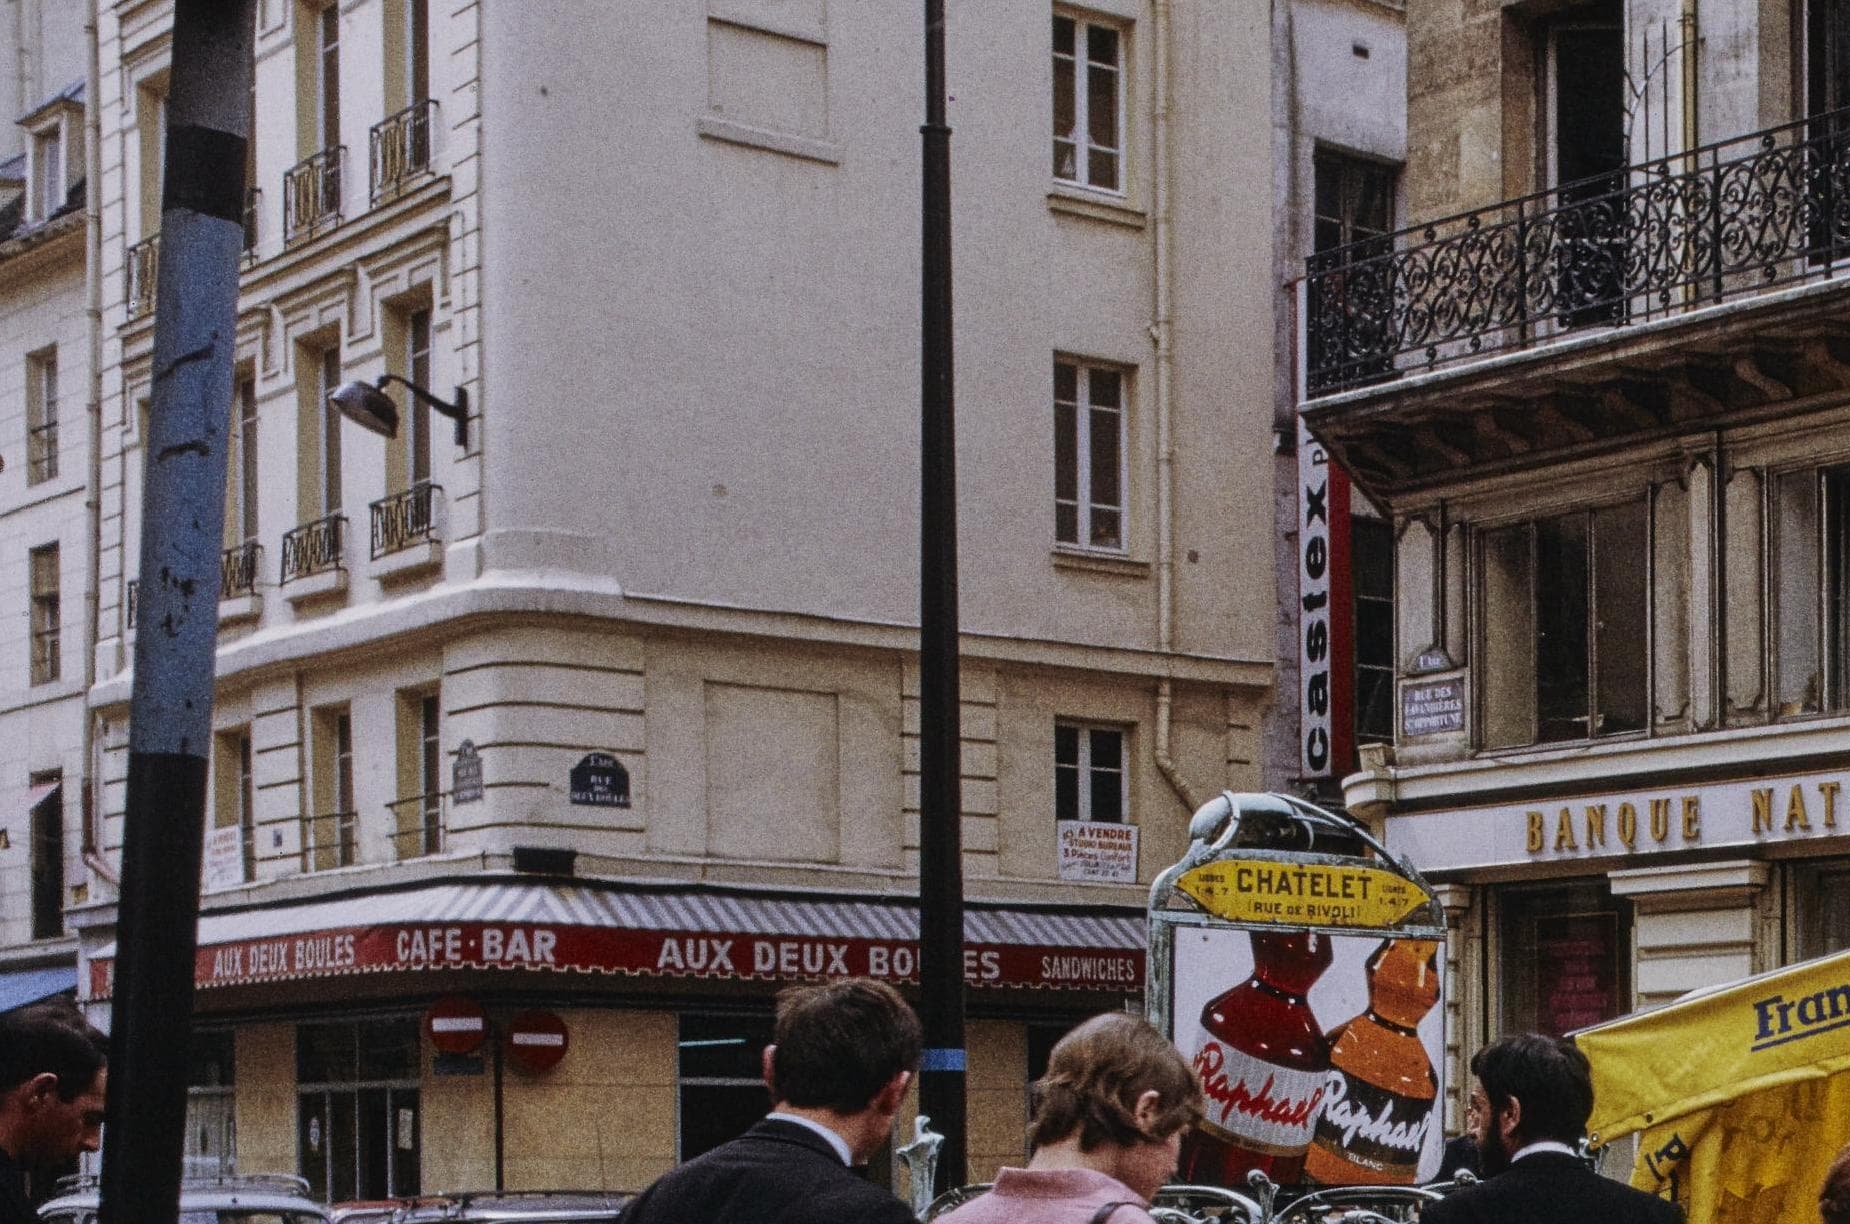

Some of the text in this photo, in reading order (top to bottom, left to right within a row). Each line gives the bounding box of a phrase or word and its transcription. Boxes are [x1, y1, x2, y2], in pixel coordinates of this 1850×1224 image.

[1088, 827, 1133, 841] VENDRE
[1525, 796, 1702, 854] BANQUE
[1236, 868, 1373, 900] CHATELET
[213, 935, 356, 977] AUX DEUX BOULES
[482, 927, 558, 964] BAR
[657, 938, 1000, 980] AUX DEUX BOES
[1041, 955, 1136, 983] SANDWICHES
